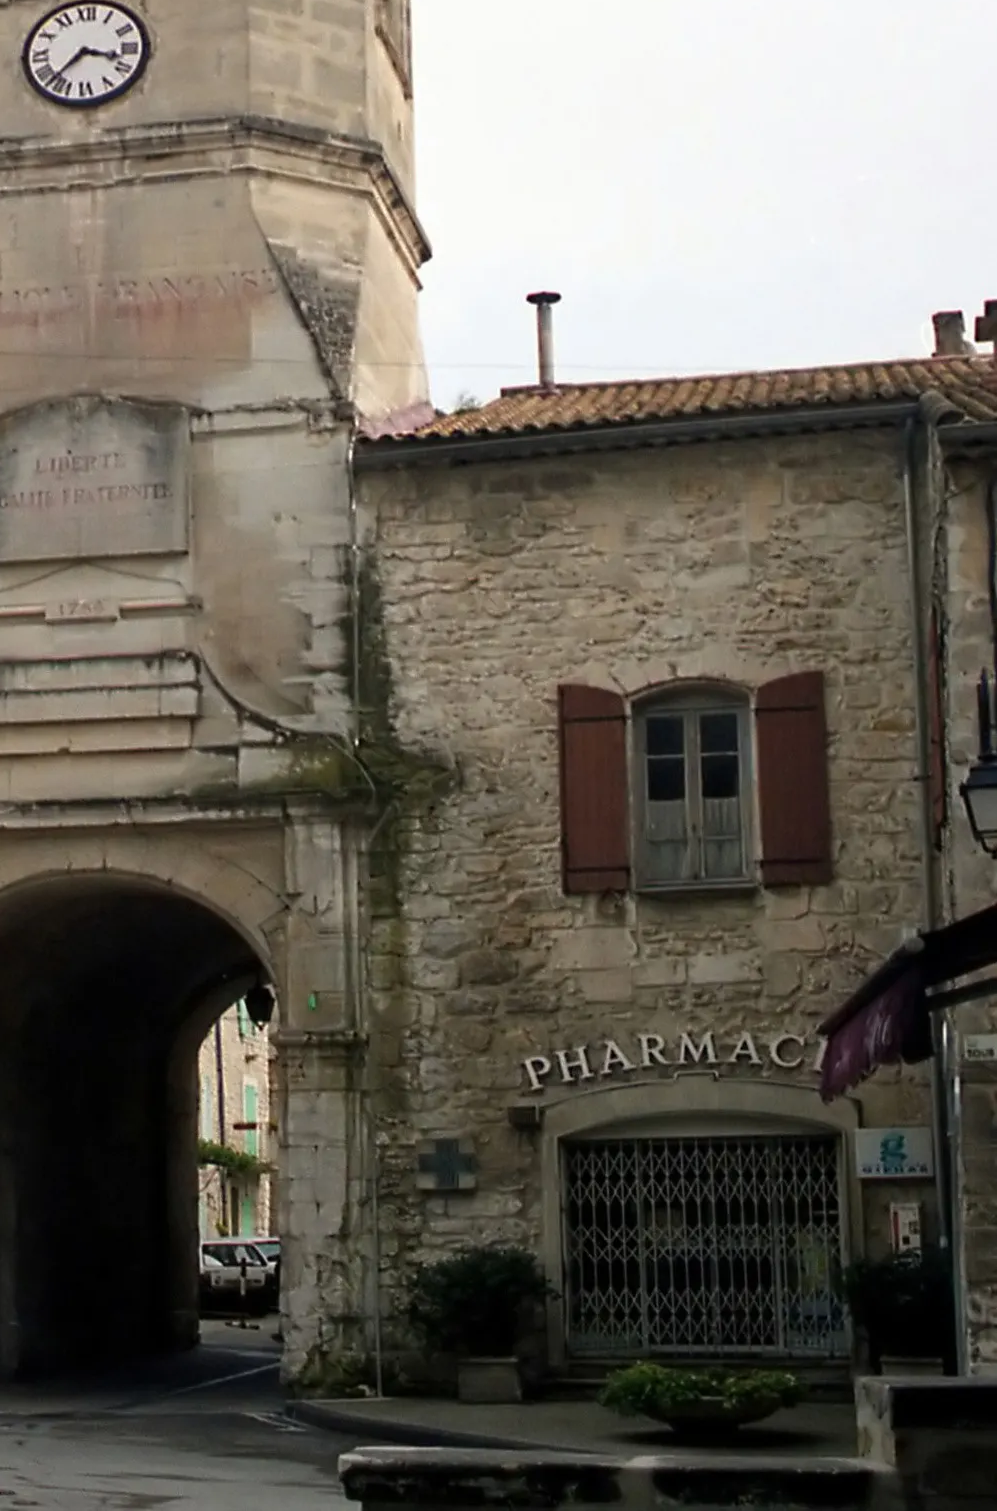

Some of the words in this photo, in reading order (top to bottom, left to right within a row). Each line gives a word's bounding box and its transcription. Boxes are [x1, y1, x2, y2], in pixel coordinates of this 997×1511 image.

[55, 12, 74, 29] XI
[77, 6, 97, 22] XII
[103, 10, 113, 24] I
[39, 30, 57, 43] X
[32, 48, 49, 63] IX
[521, 1031, 827, 1091] PHARMACI
